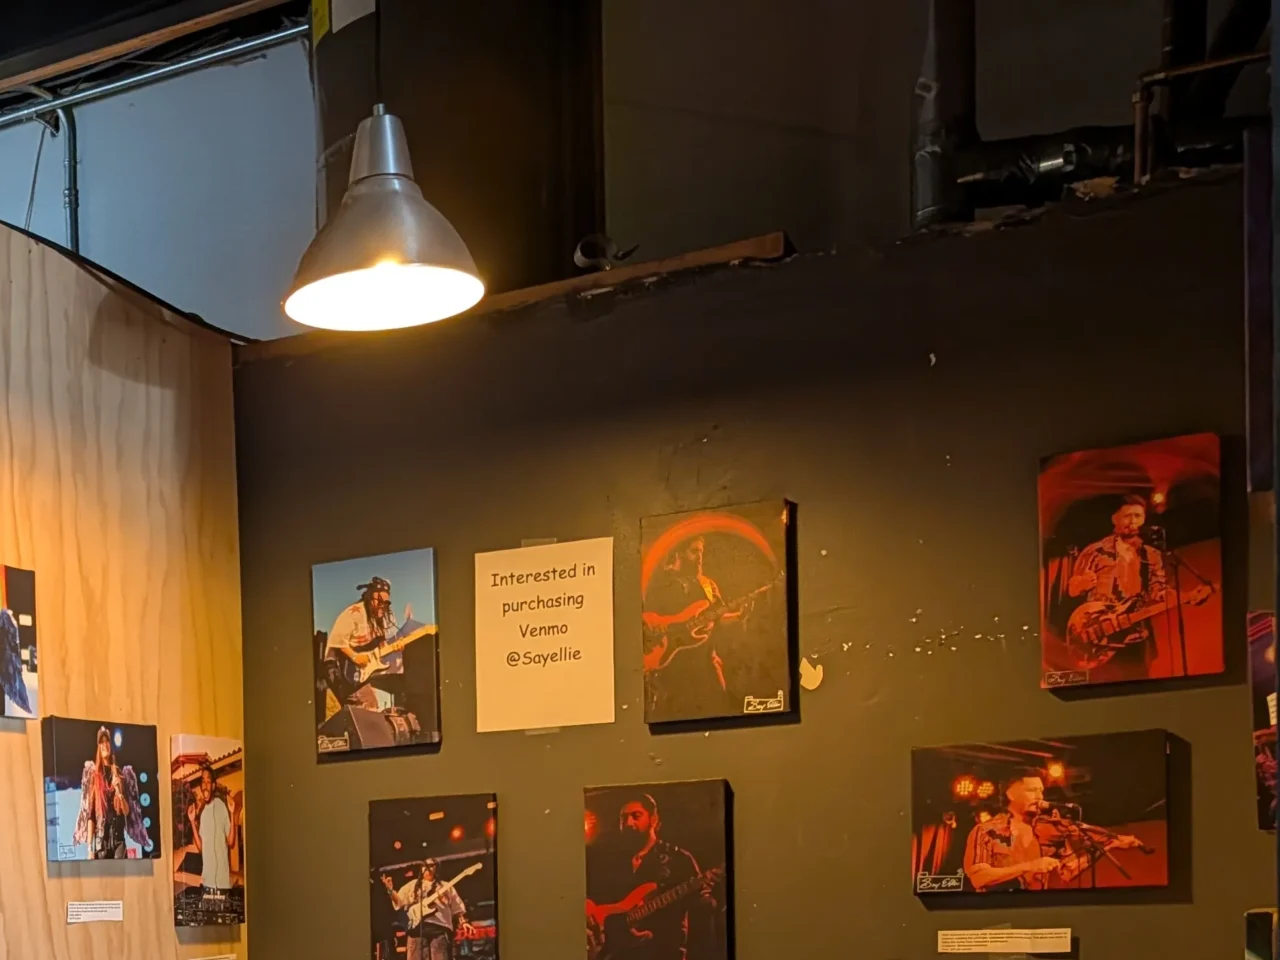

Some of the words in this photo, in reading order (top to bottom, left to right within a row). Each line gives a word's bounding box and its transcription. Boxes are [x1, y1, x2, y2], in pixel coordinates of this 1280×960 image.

[491, 563, 577, 587] Interested
[582, 562, 596, 577] in
[502, 592, 584, 617] purchasing
[519, 623, 568, 638] Venmo
[506, 647, 582, 667] @Sayellie
